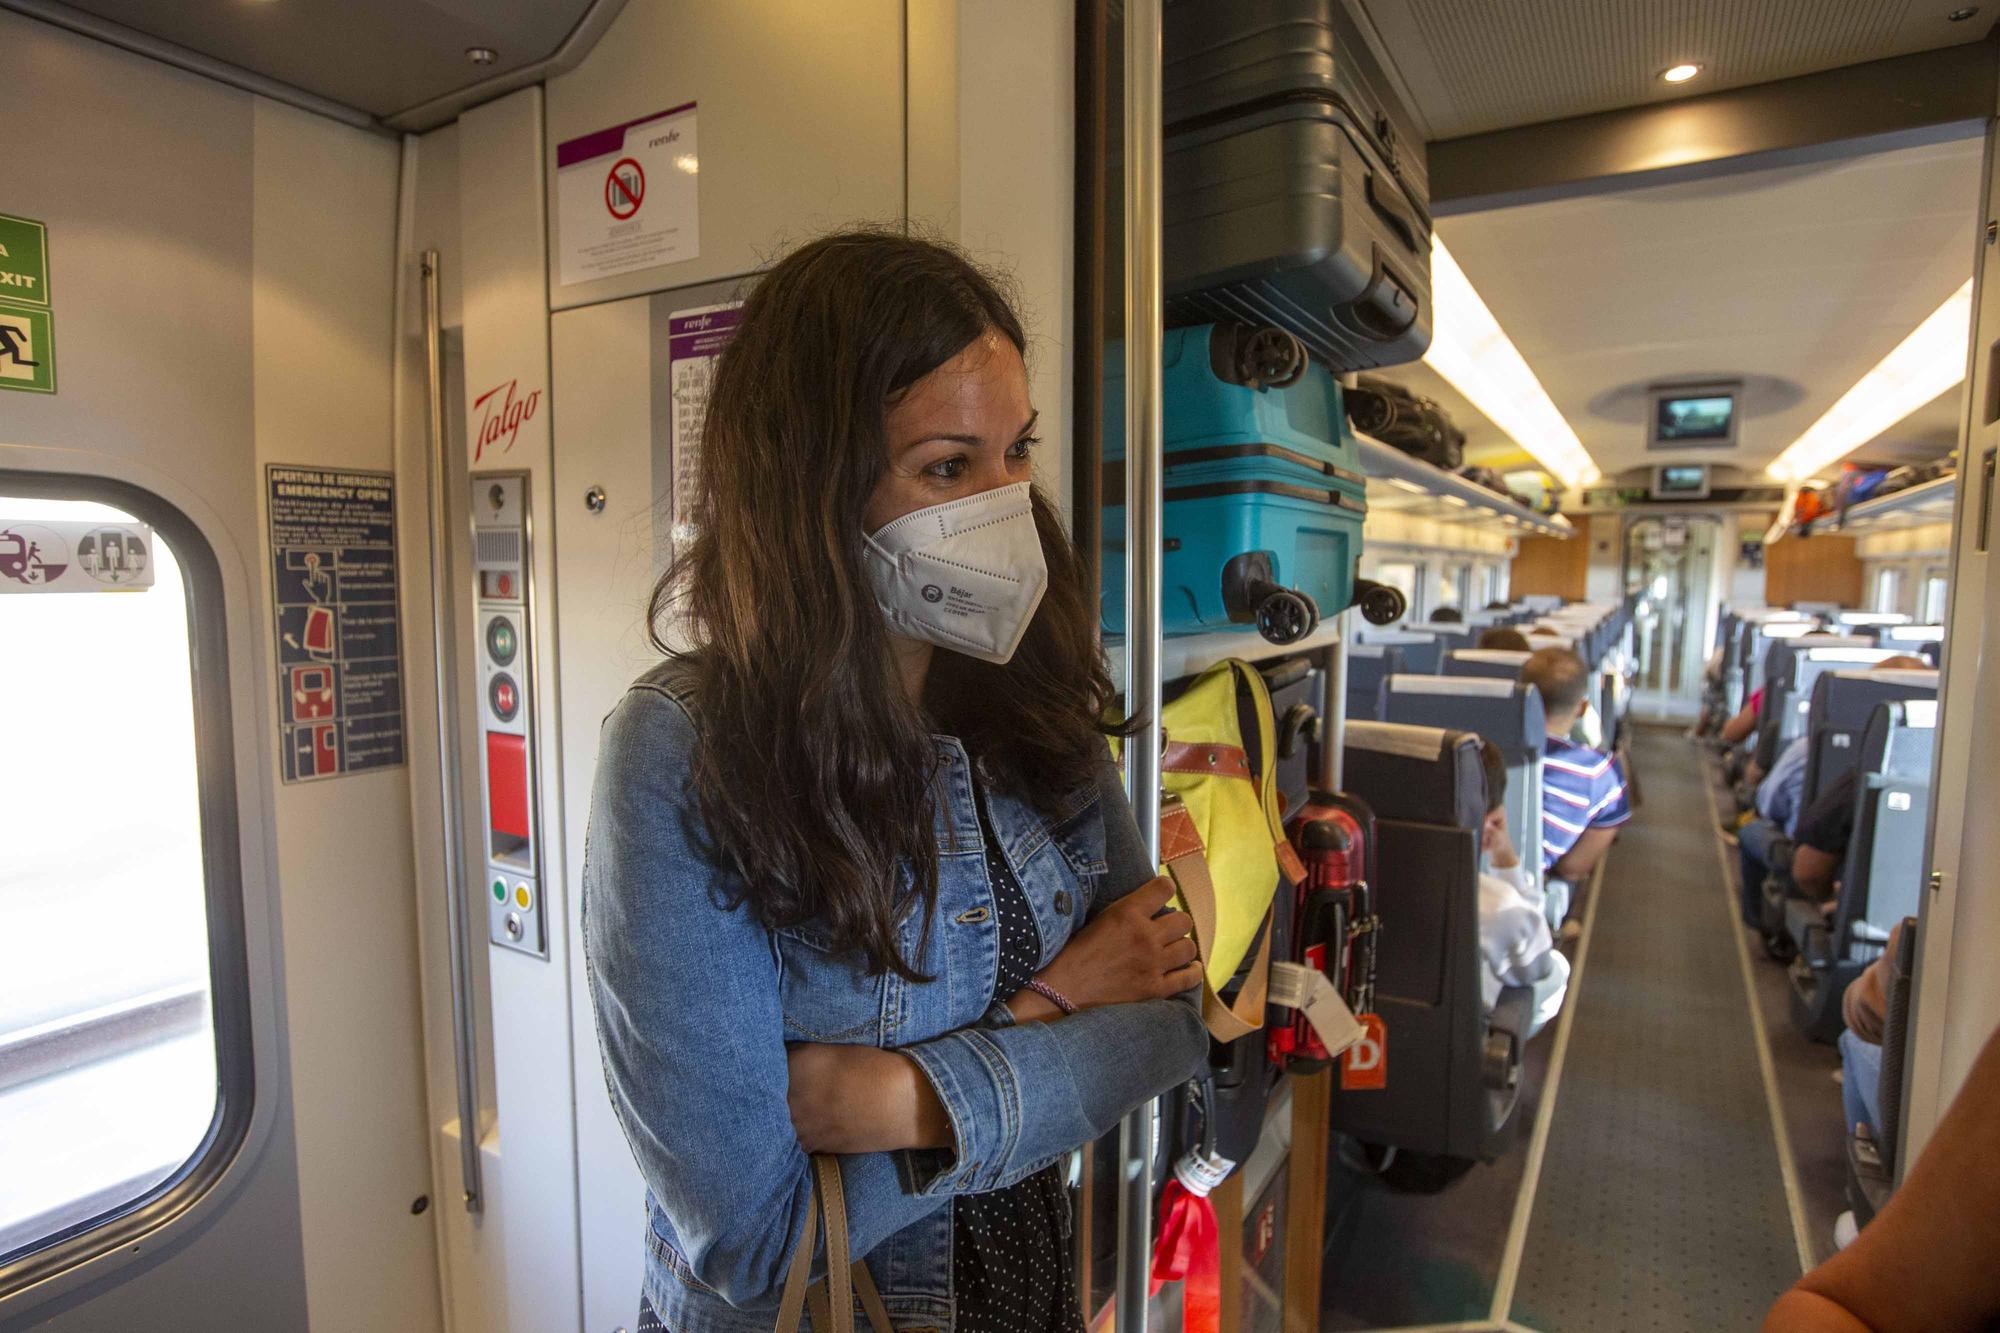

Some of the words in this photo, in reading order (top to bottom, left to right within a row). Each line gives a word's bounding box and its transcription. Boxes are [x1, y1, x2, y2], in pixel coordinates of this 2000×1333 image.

[649, 129, 680, 149] renfe
[0, 271, 36, 288] XIT
[474, 379, 542, 464] Talgo
[277, 484, 354, 499] EMERGENCY
[357, 489, 388, 501] OPEN
[950, 586, 973, 599] Béjar
